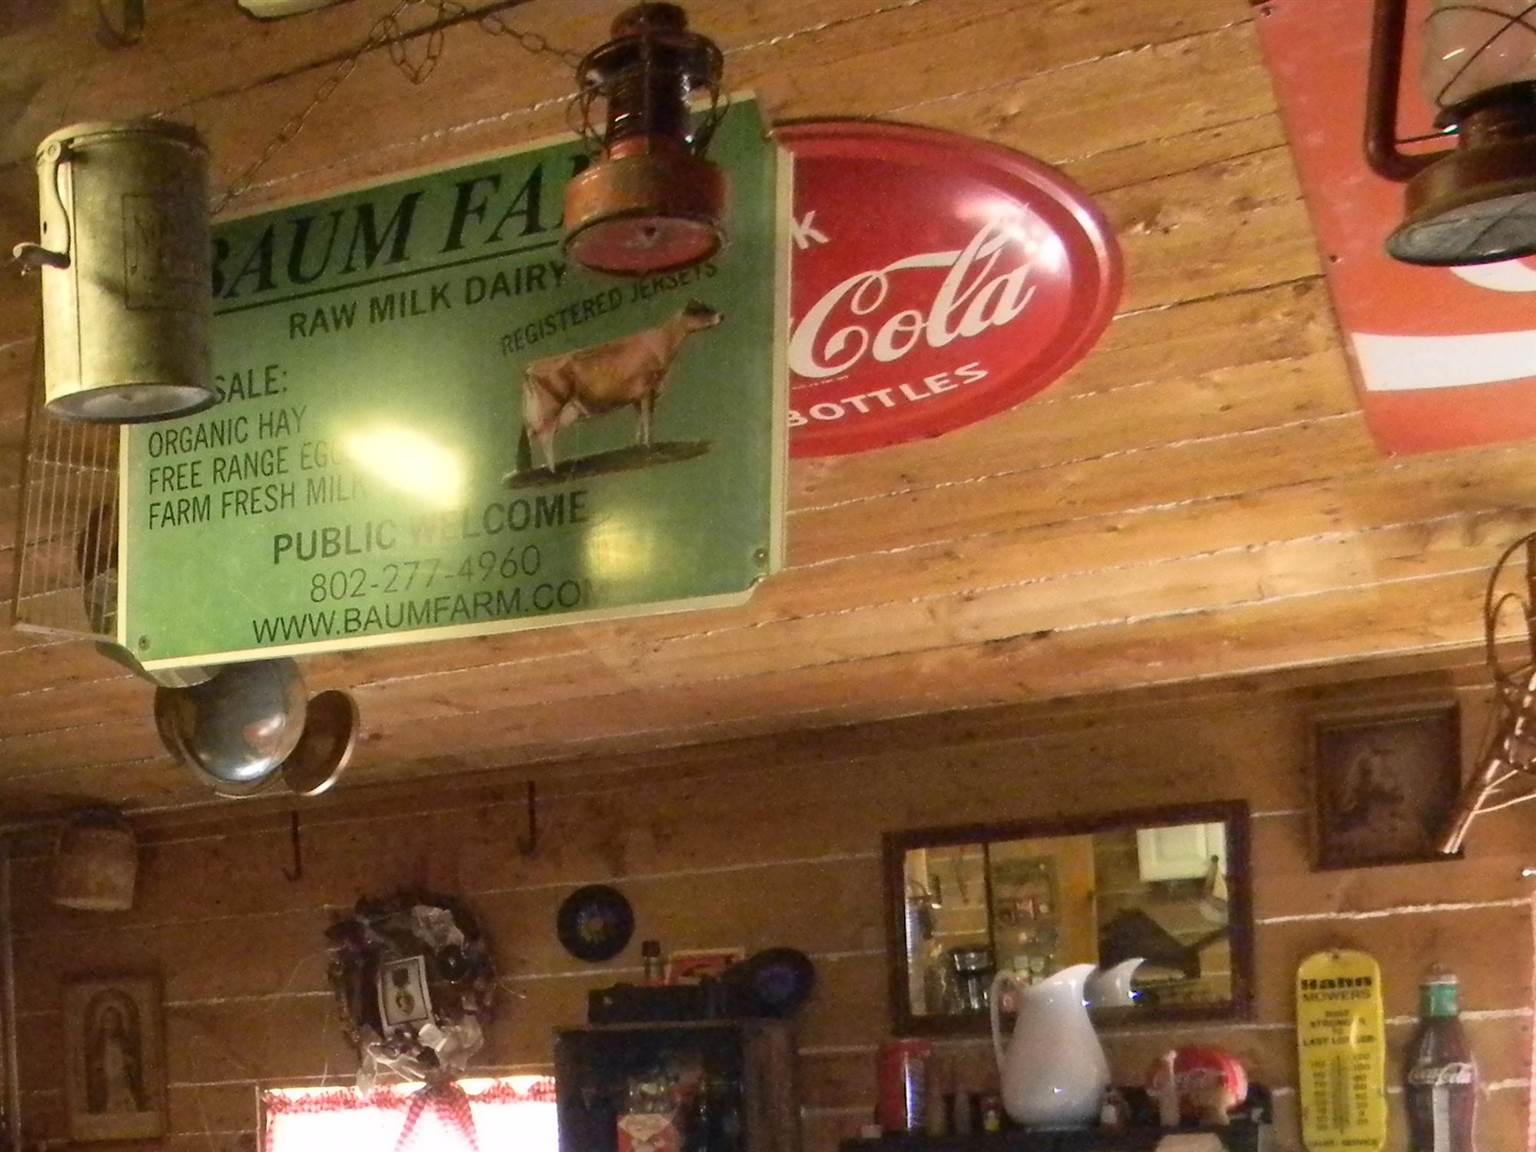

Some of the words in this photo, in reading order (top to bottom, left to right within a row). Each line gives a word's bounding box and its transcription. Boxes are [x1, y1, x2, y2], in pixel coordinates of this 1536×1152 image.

[439, 151, 591, 254] FA
[289, 301, 357, 339] RAW
[369, 282, 452, 325] MILK
[465, 262, 567, 306] DAIRY
[500, 287, 624, 357] REGISTERED
[214, 364, 288, 405] SALE:
[148, 415, 249, 459] ORGANIC
[259, 405, 308, 441] HAY
[149, 460, 202, 495] FREE
[214, 446, 288, 485] RANGE
[149, 494, 210, 530] FARM
[221, 482, 295, 519] FRESH
[273, 518, 397, 565] PUBLIC
[411, 489, 589, 551] WELCOME
[309, 544, 542, 604] 802-277-4960
